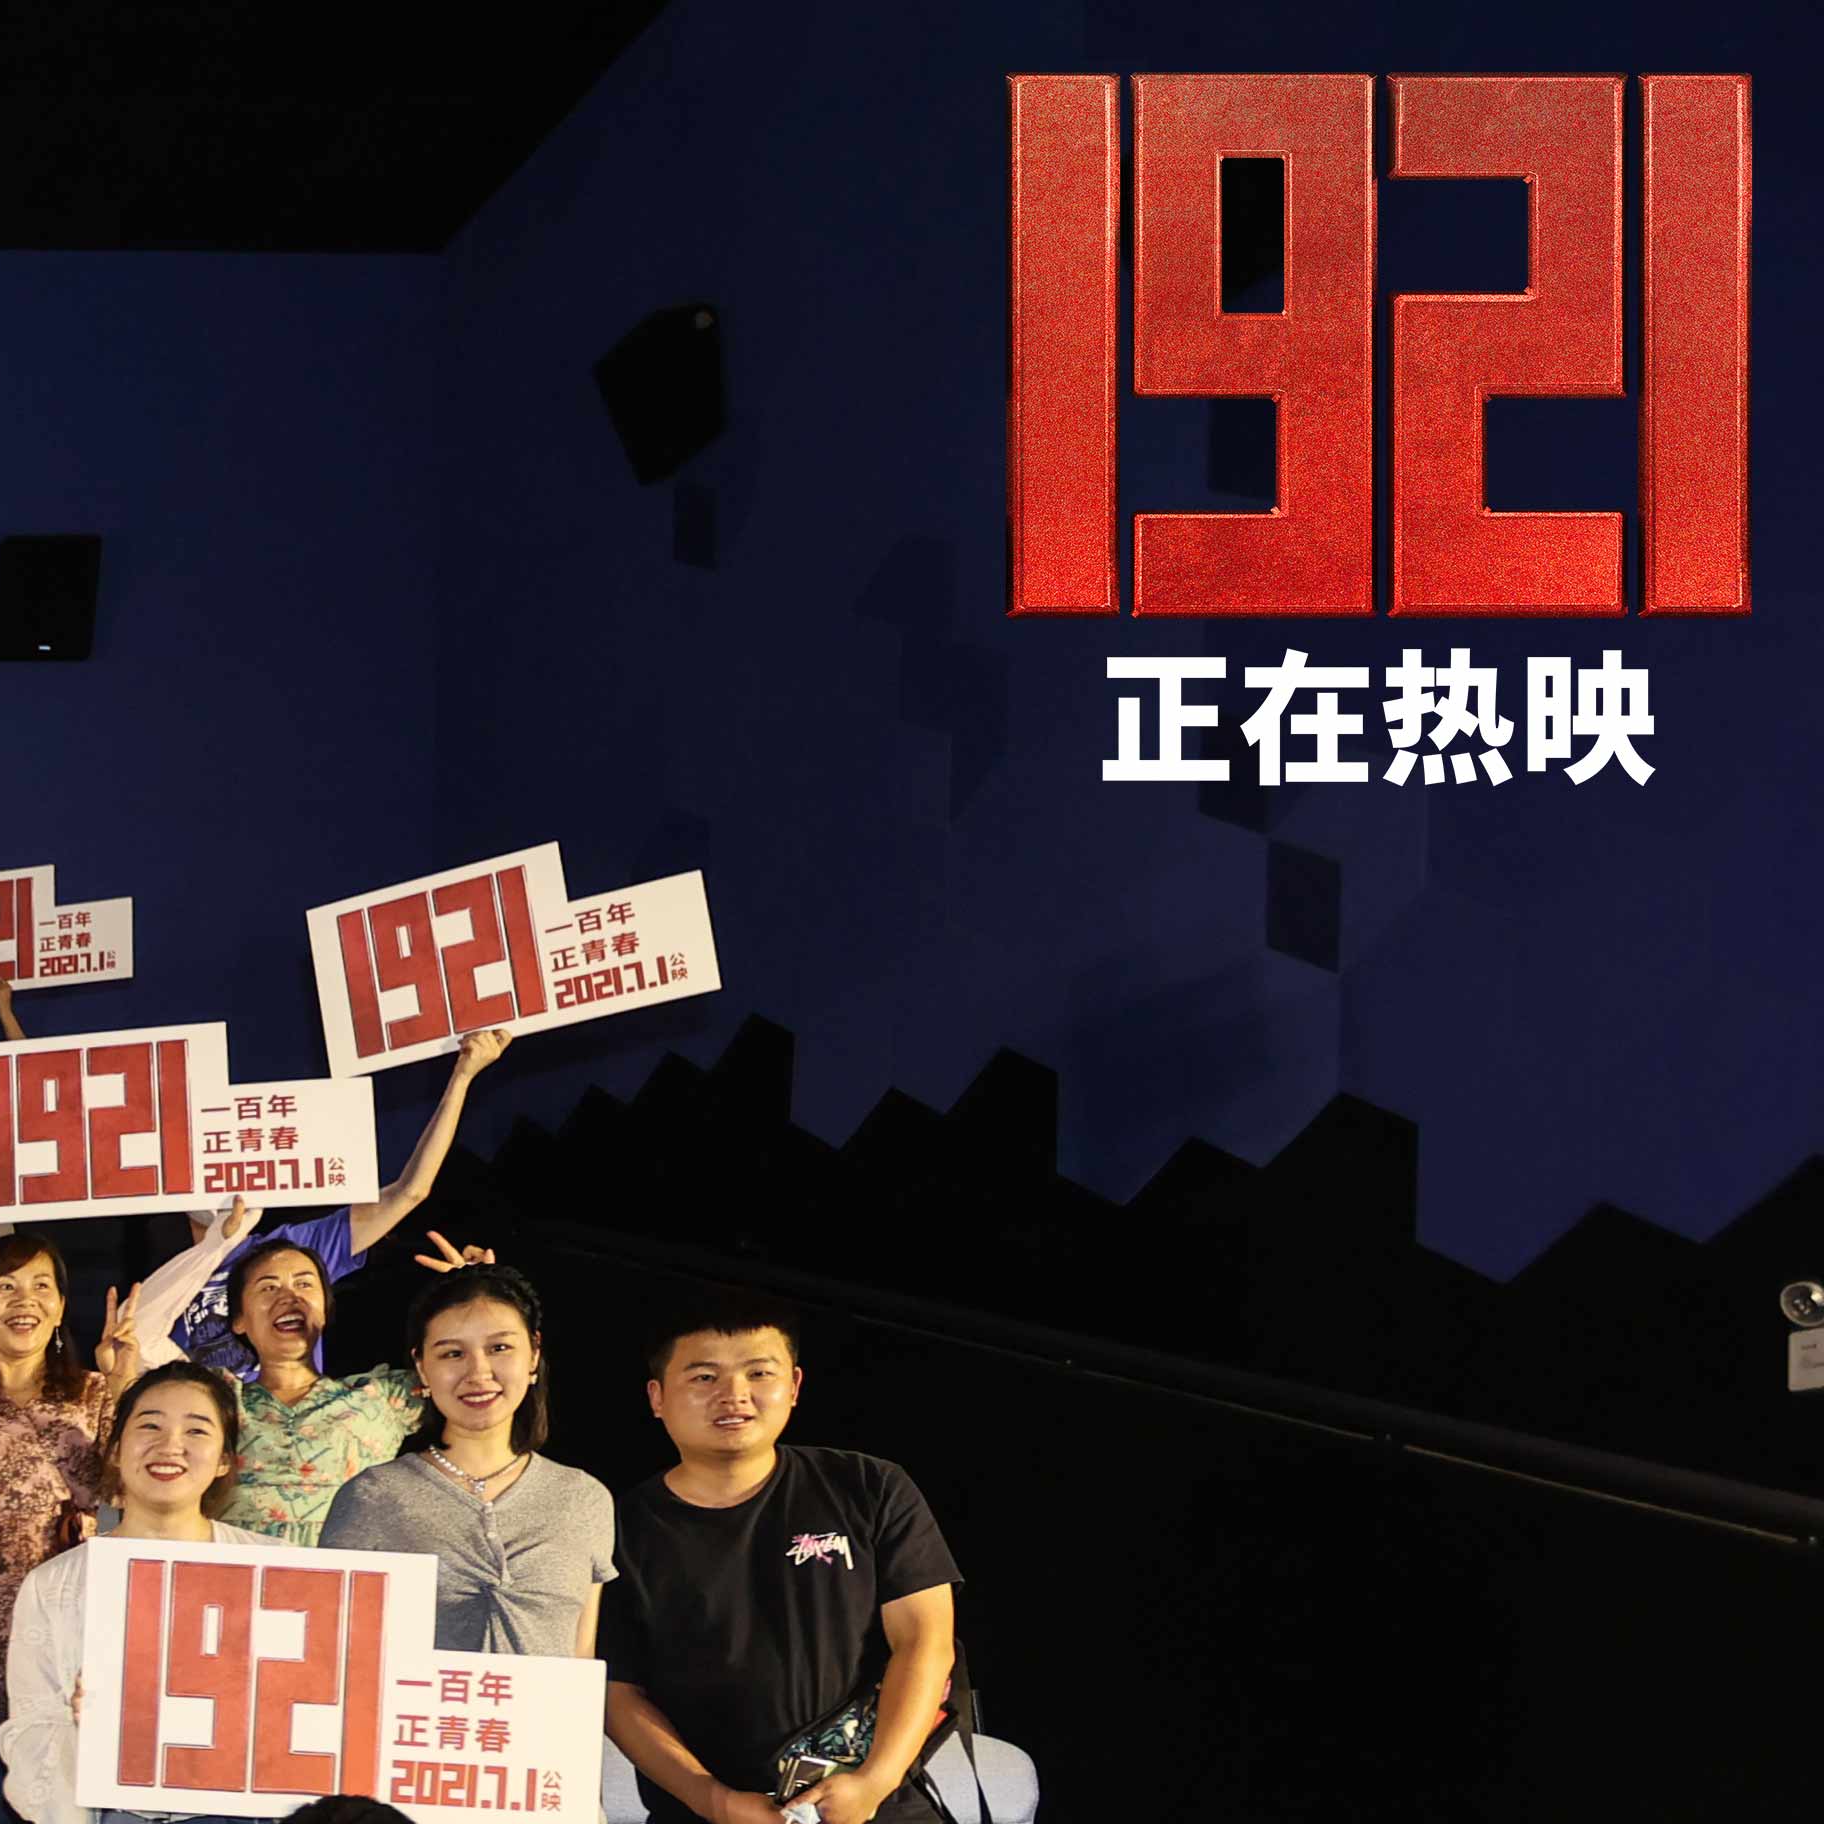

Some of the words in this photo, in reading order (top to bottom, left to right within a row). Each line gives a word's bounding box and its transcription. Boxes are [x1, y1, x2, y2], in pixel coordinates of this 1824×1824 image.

[39, 911, 92, 929] 一百年
[545, 901, 635, 934] 一百年
[40, 932, 92, 952] 正青春
[550, 931, 640, 972] 正青春
[40, 951, 104, 977] 2021.7.1
[337, 865, 548, 1059] 1921
[554, 956, 670, 1010] 2021.7.1
[201, 1095, 297, 1119] 一百年
[204, 1127, 299, 1154] 正青春
[204, 1158, 324, 1193] 2021.7.1
[118, 1558, 389, 1795] 1921
[396, 1669, 512, 1705] 一百年
[394, 1714, 511, 1753] 正青春
[390, 1760, 538, 1811] 2021.7.1
